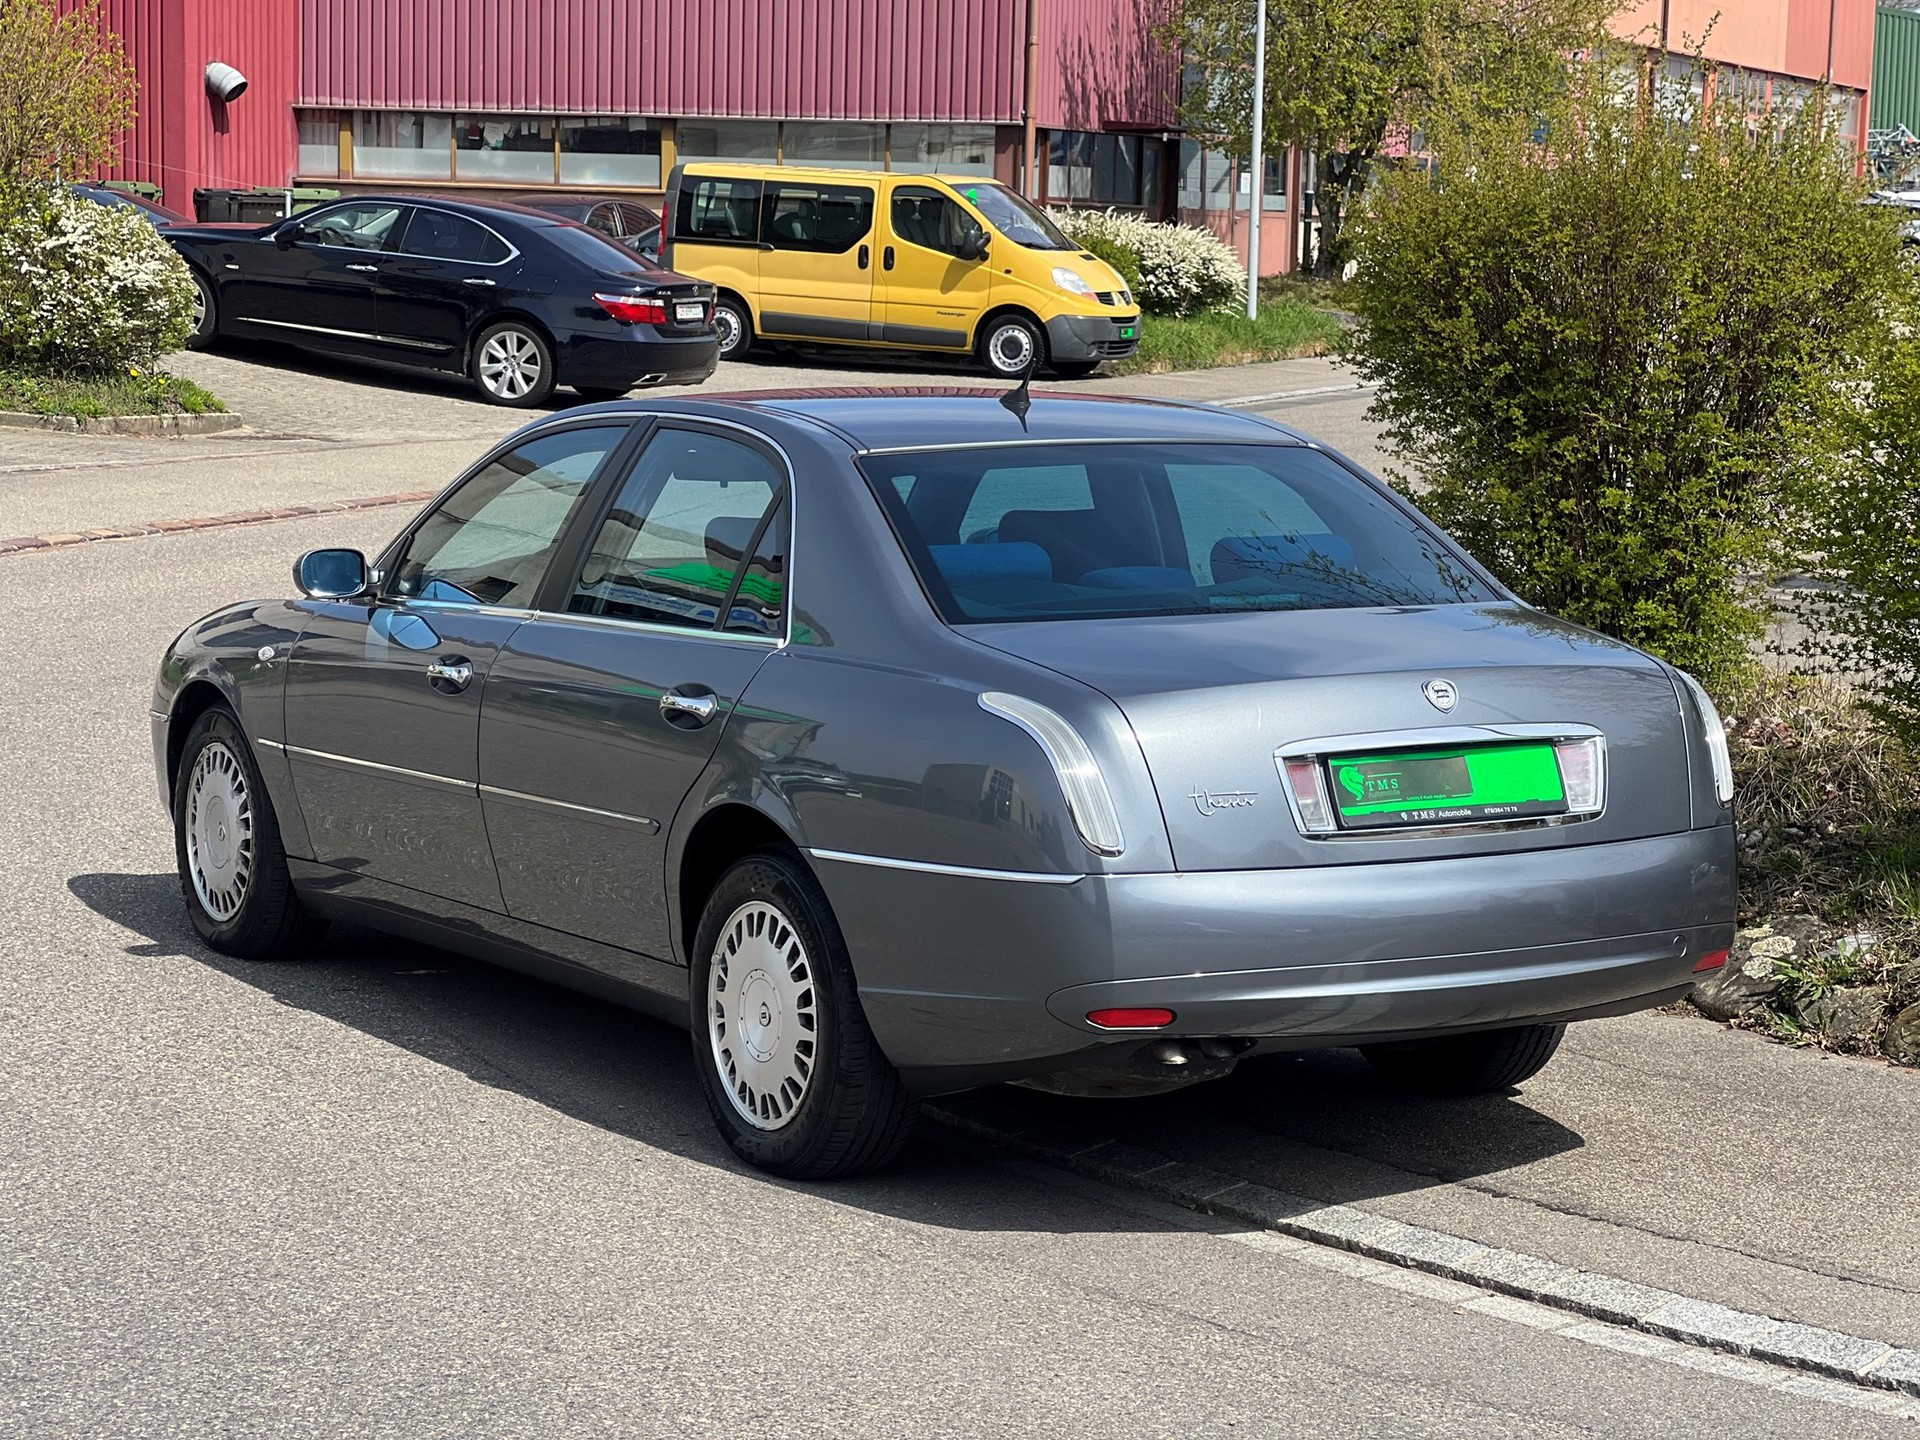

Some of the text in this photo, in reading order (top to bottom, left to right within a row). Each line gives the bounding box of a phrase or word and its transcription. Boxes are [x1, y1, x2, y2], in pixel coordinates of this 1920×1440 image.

[1365, 778, 1399, 792] TMS
[1412, 808, 1472, 820] TMS Automobile
